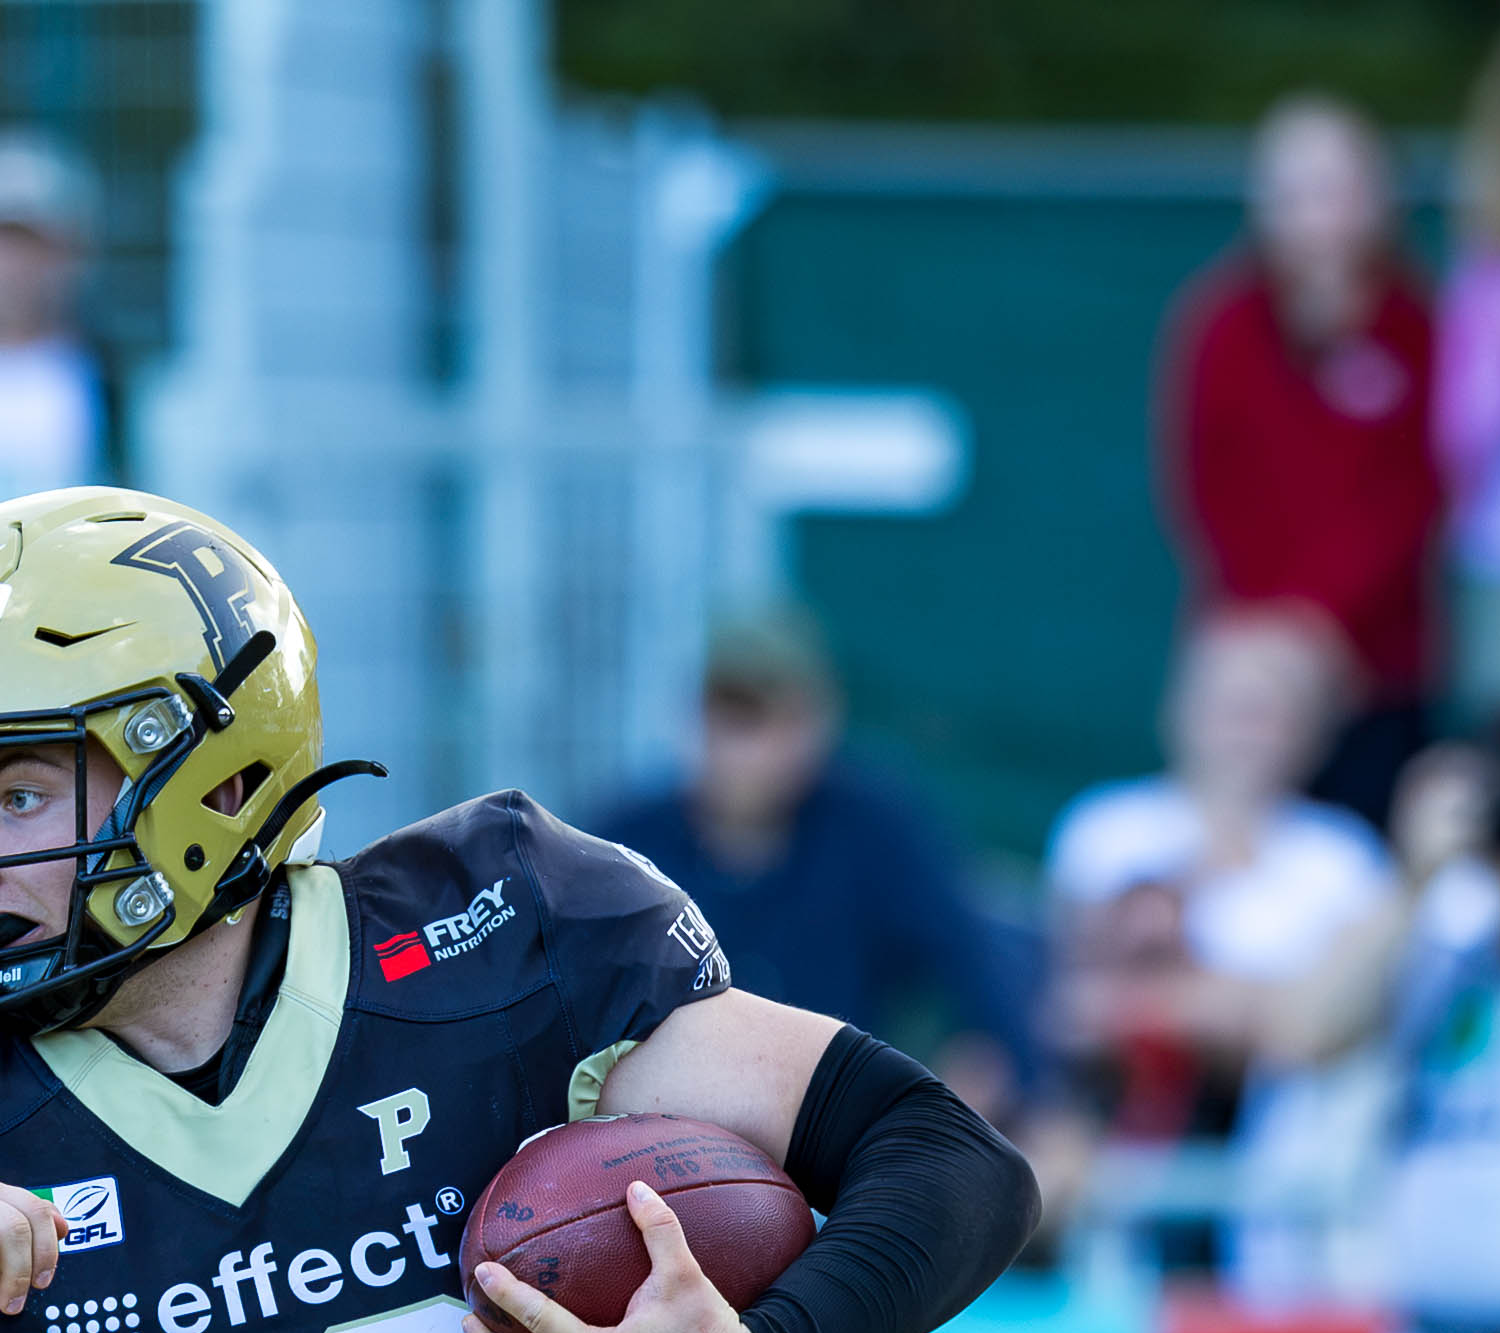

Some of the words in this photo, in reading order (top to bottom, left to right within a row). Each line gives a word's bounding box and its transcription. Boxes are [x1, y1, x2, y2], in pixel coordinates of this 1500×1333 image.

[423, 878, 507, 948] FREY
[434, 905, 517, 962] NUTRITION
[356, 1087, 431, 1176] P
[63, 1225, 118, 1246] GFL
